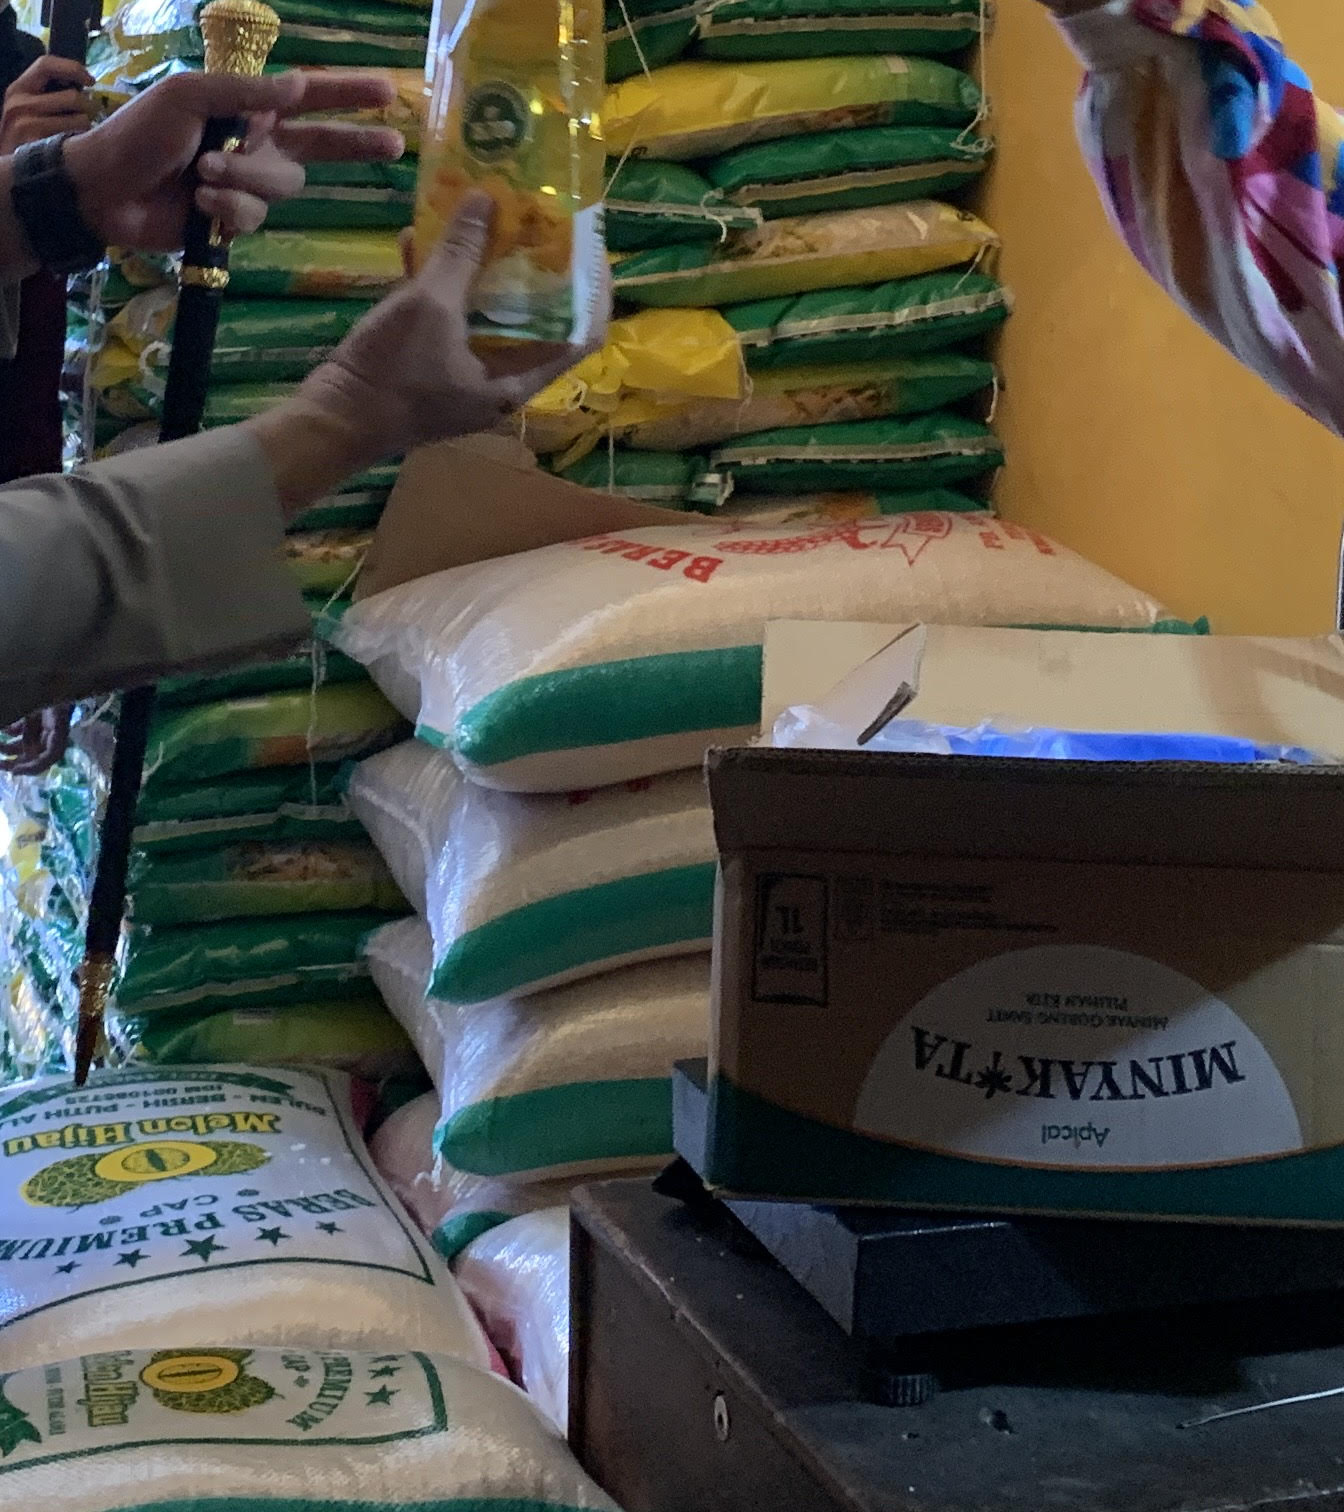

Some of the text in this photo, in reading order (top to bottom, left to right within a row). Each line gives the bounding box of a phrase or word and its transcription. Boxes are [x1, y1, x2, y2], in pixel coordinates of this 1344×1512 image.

[44, 1102, 119, 1121] PUTIH
[3, 1110, 282, 1158] Melon Hijau
[1041, 1121, 1111, 1149] Apical
[140, 1192, 219, 1218] CAP
[233, 1188, 377, 1223] BERAS
